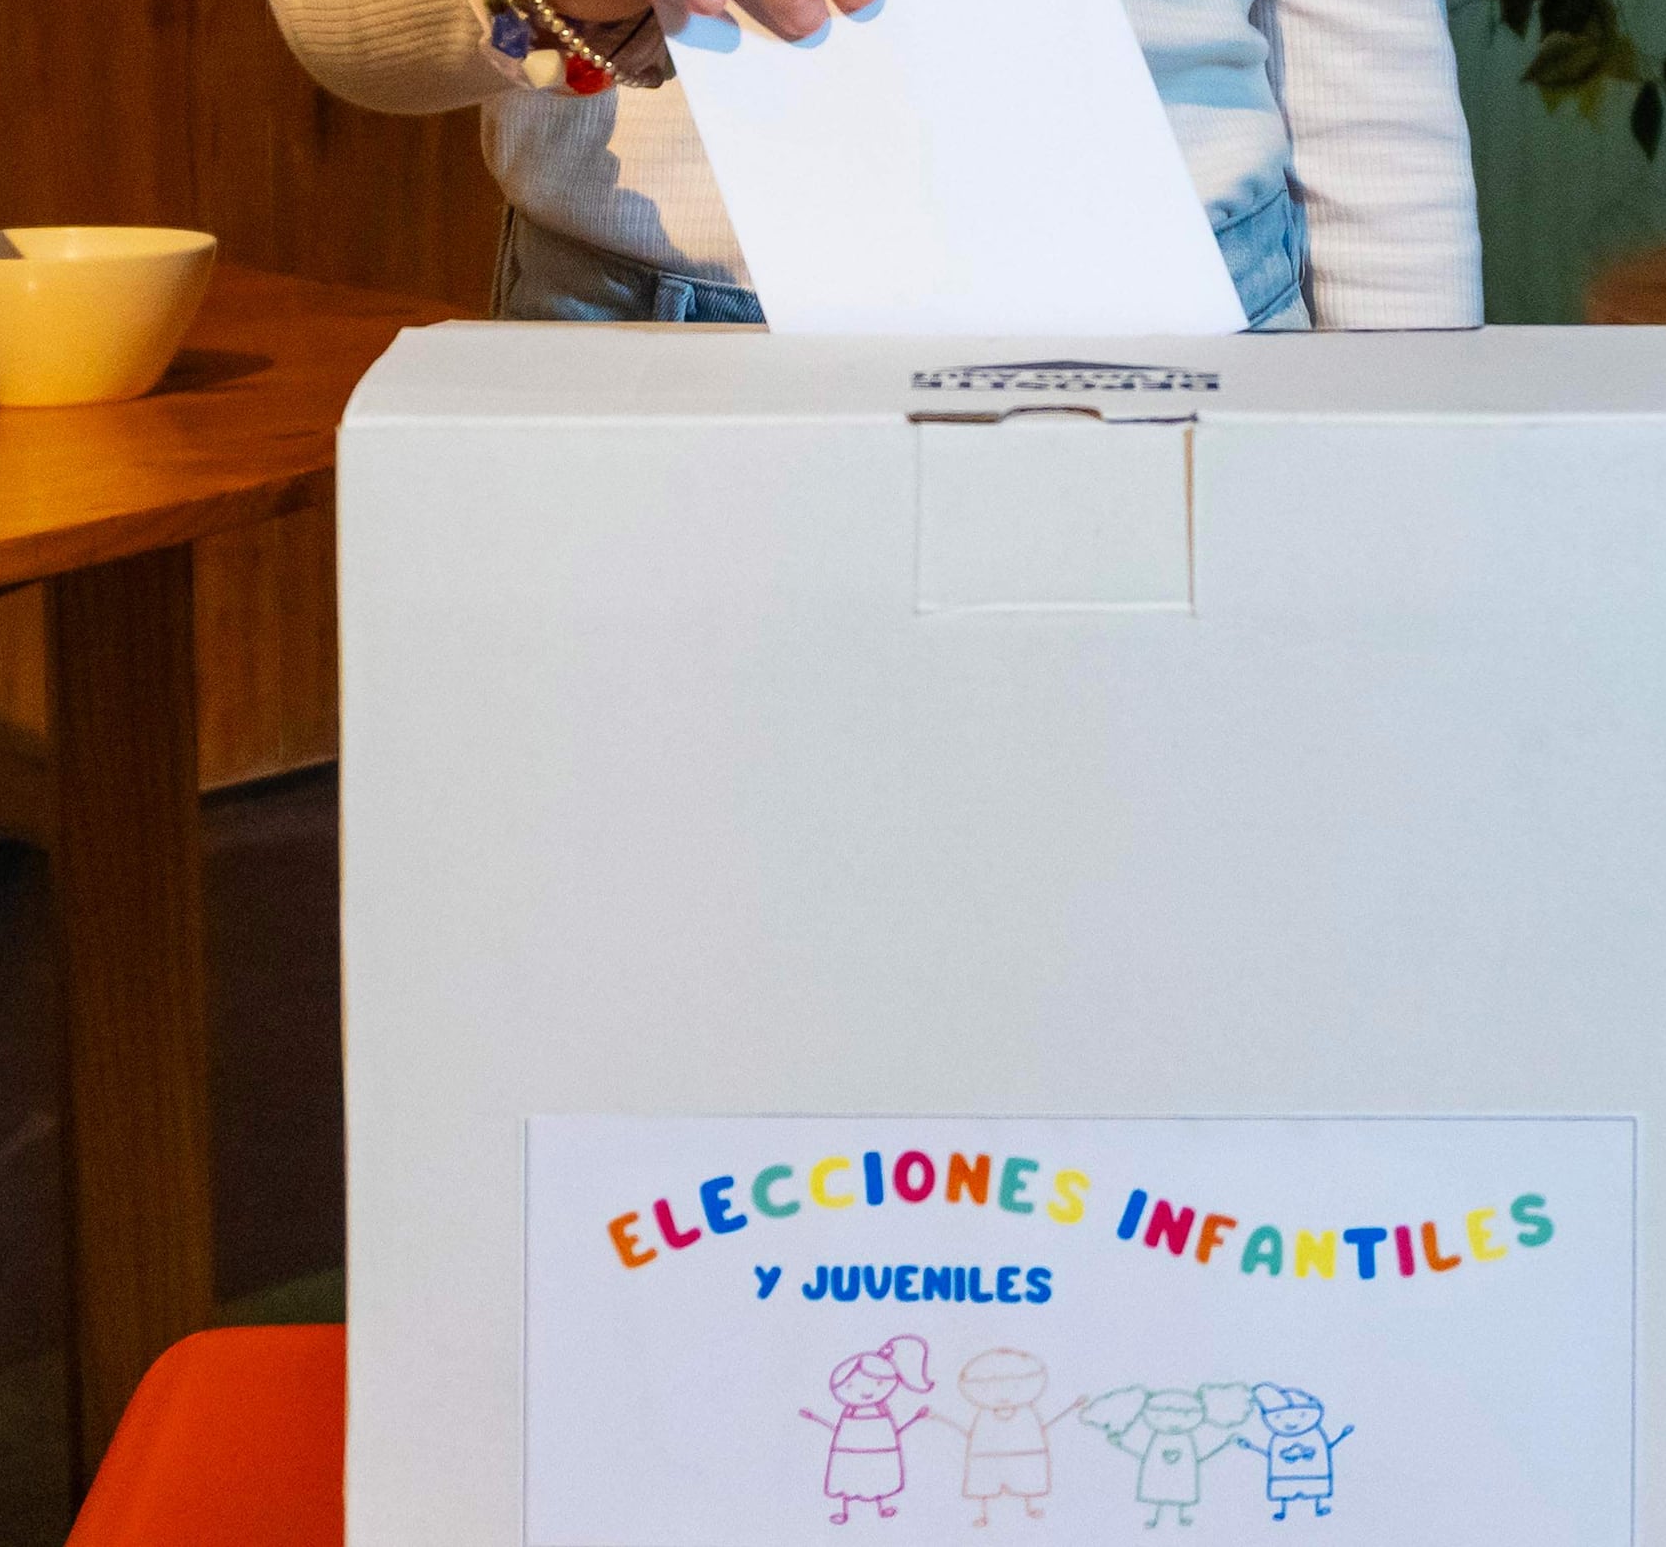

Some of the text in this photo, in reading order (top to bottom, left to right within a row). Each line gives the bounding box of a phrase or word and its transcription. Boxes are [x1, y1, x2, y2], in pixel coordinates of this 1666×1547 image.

[608, 1150, 1553, 1280] ELECCIONES INFANTILES
[802, 1263, 1053, 1304] JUVENILES
